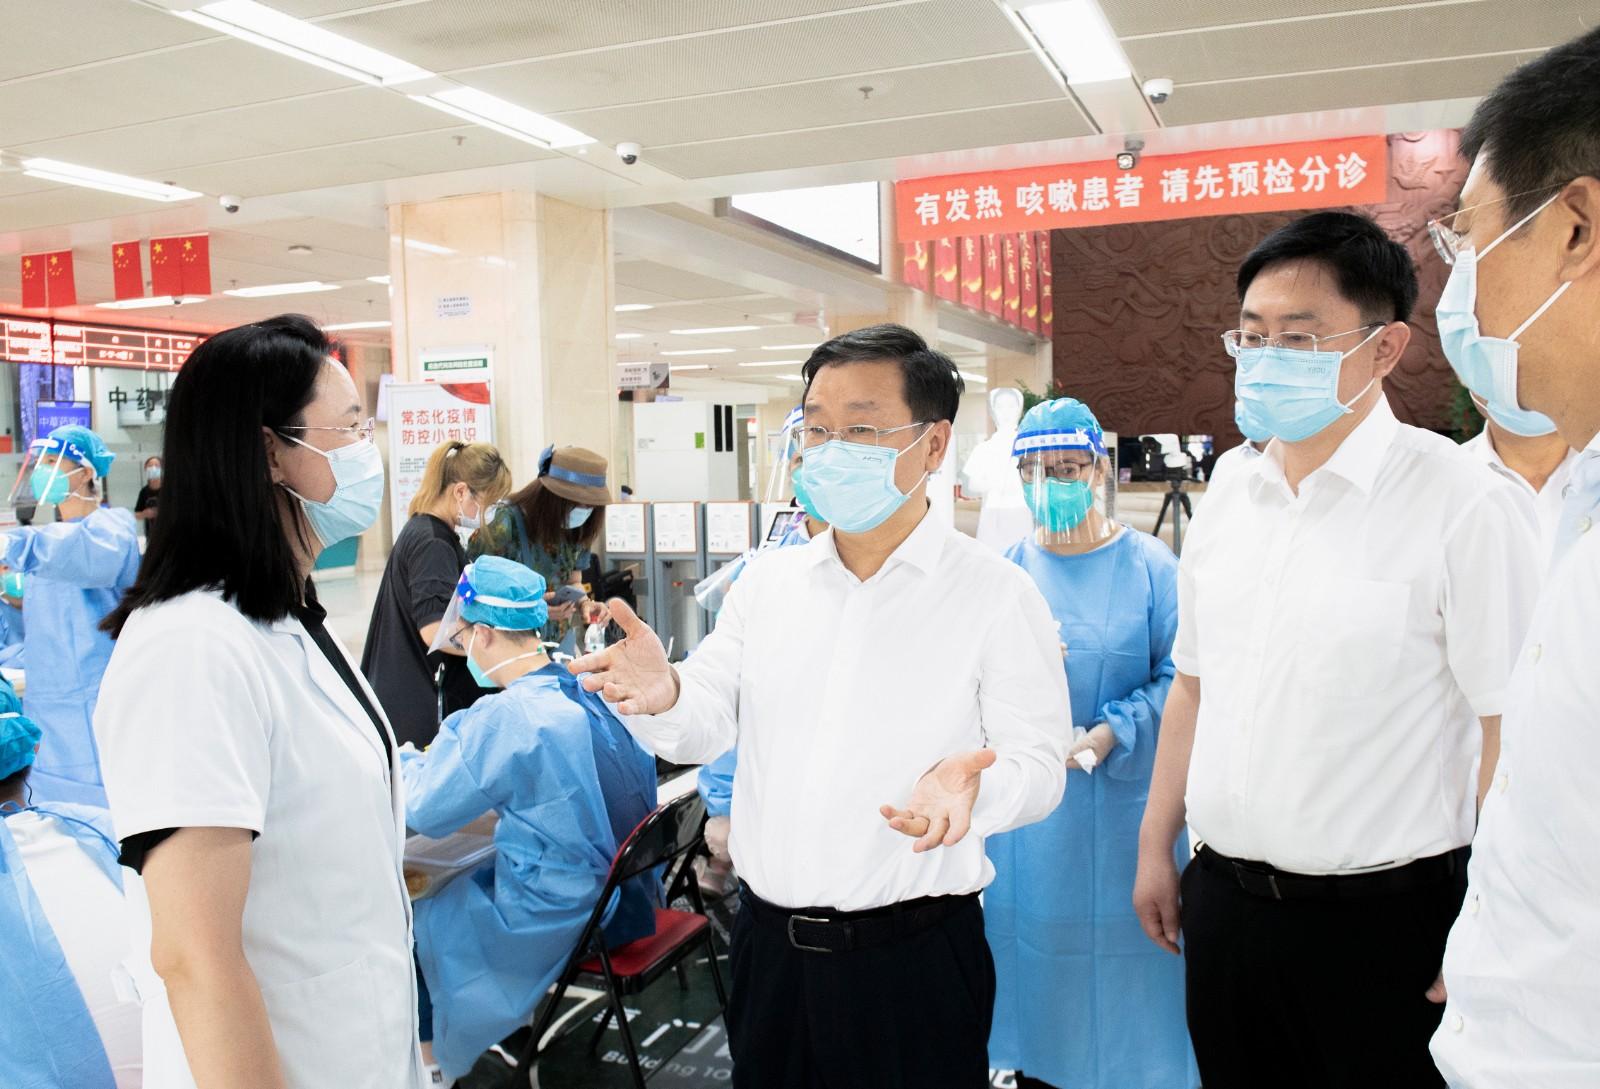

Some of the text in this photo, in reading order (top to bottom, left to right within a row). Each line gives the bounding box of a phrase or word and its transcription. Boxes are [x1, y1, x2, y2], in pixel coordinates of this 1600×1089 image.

[914, 152, 1368, 226] 有发热 咳嗽患者 请先预检分诊
[109, 386, 170, 411] 中药
[401, 408, 476, 425] 常态化疫情
[402, 427, 476, 445] 防控小知识
[601, 1050, 697, 1077] Buldng
